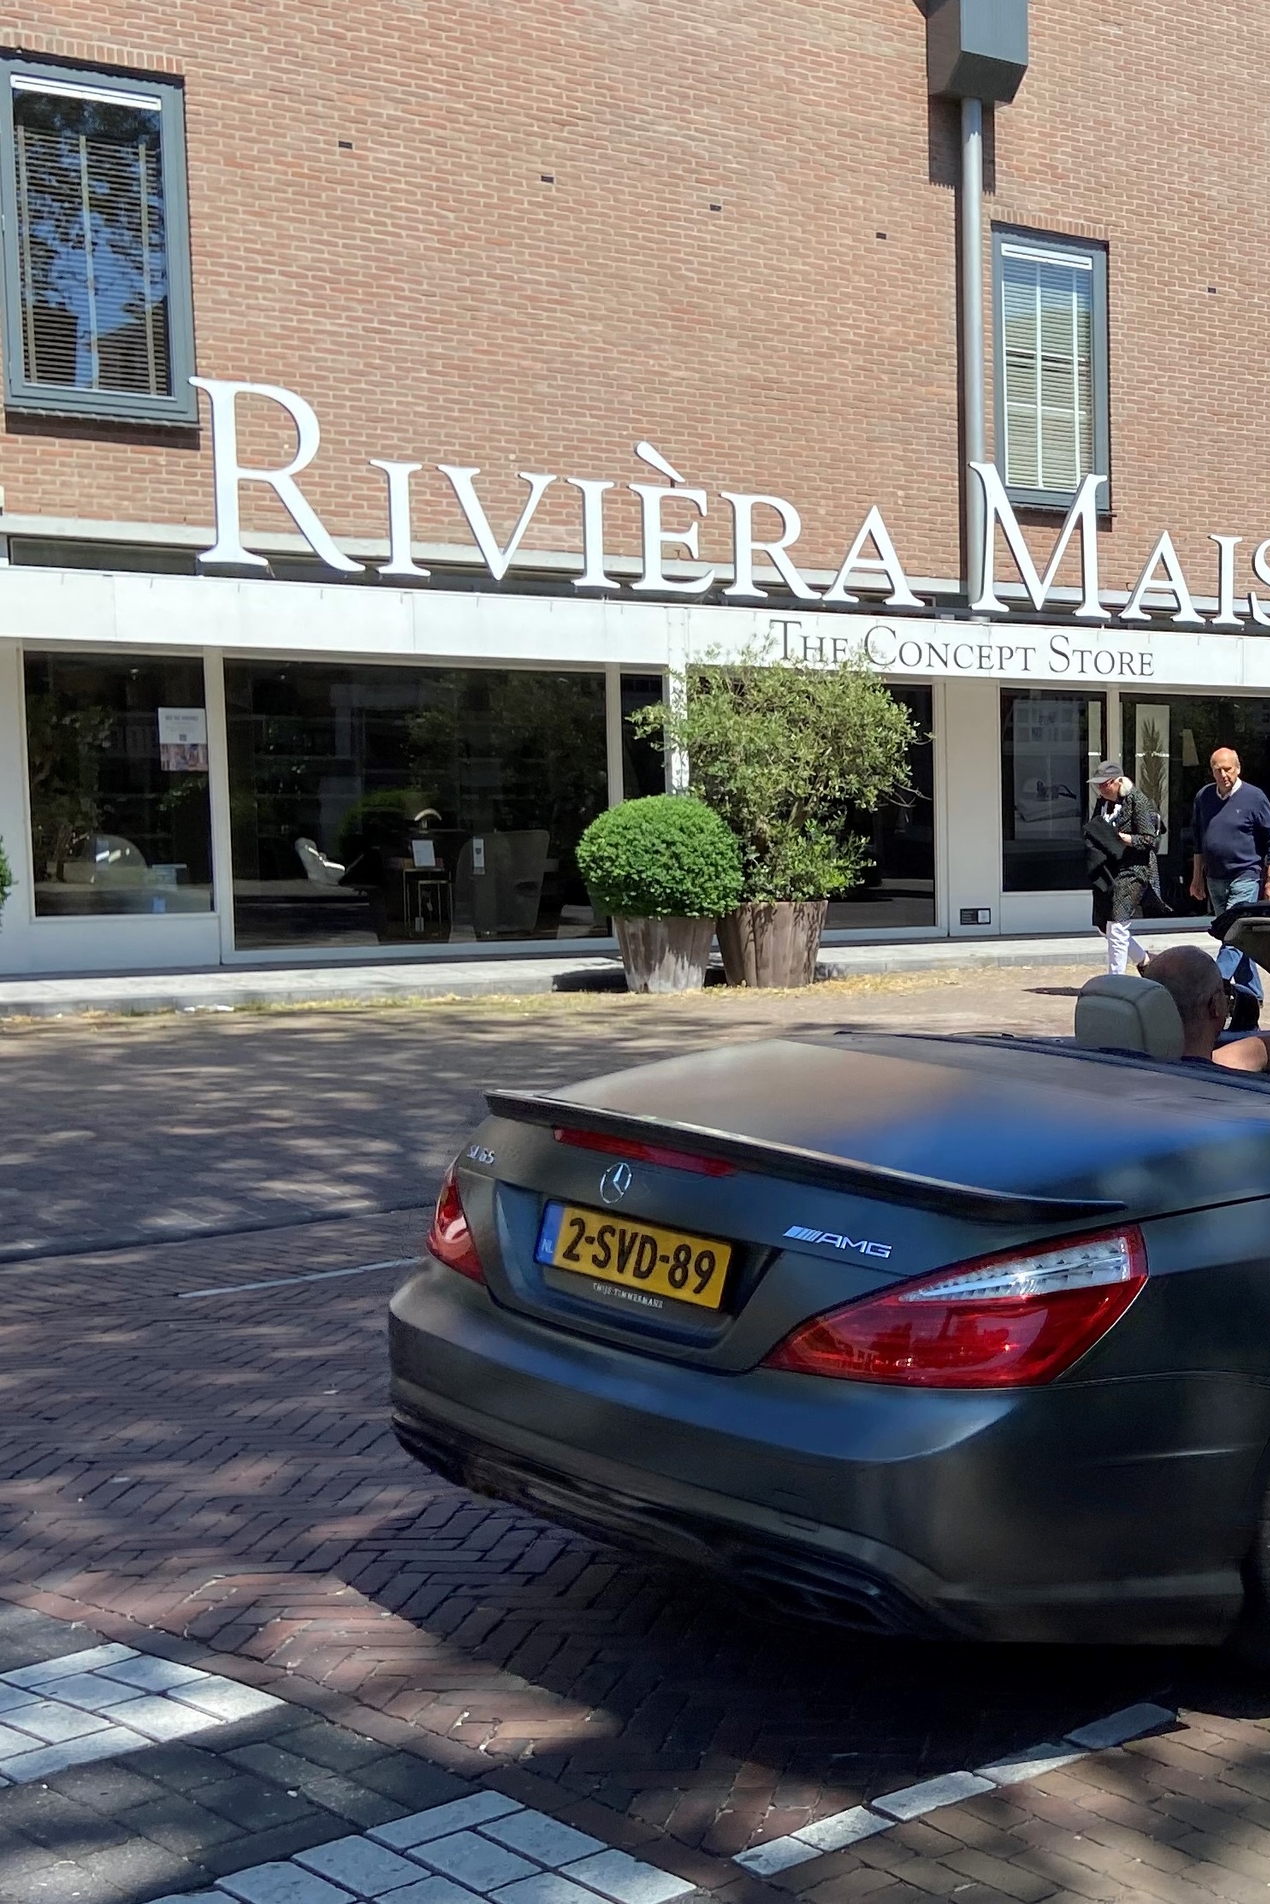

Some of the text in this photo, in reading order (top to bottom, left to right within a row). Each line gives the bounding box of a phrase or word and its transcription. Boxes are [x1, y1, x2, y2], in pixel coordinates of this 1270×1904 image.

[189, 376, 926, 608] RIVIÈRA
[769, 618, 1155, 677] THE CONCEPT STORE
[541, 1238, 554, 1254] NL
[562, 1217, 717, 1295] 2-SVD-89
[815, 1232, 893, 1259] AMG
